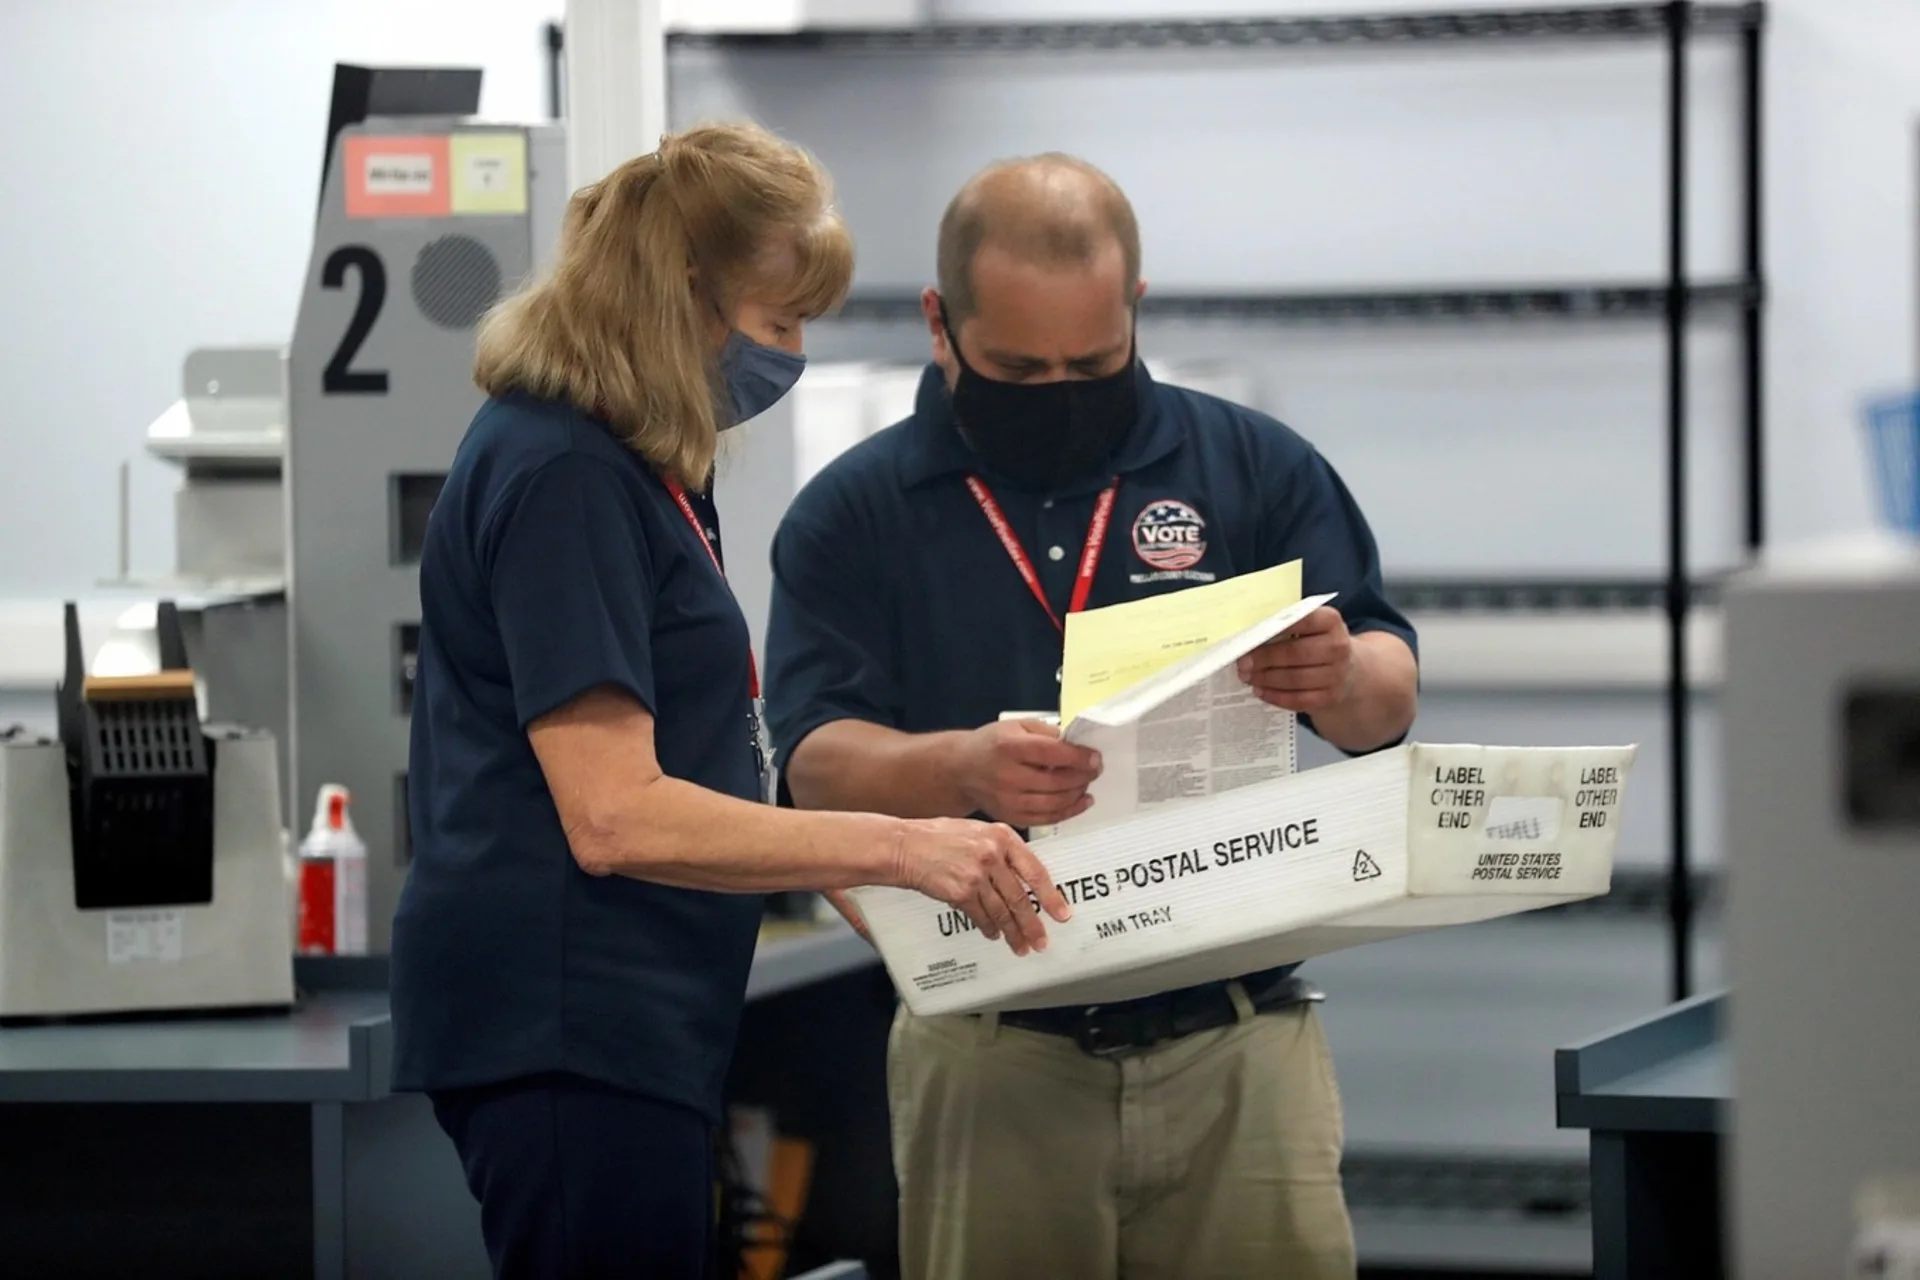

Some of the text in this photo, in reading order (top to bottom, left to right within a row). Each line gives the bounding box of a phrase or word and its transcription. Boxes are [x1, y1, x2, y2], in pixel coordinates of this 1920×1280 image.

[321, 243, 389, 396] 2
[1141, 525, 1200, 543] VOTE
[1436, 766, 1485, 784] LABEL
[1581, 767, 1618, 784] LABEL
[1431, 789, 1484, 806] OTHER
[1575, 789, 1617, 806] OTHER
[1438, 812, 1471, 828] END
[1579, 811, 1607, 828] END
[1115, 849, 1208, 891] POSTAL
[1213, 819, 1319, 867] SERVICE
[1478, 853, 1561, 866] UNITED STATES
[1472, 867, 1563, 880] POSTAL SERVICE
[1096, 906, 1172, 938] MM TRAY
